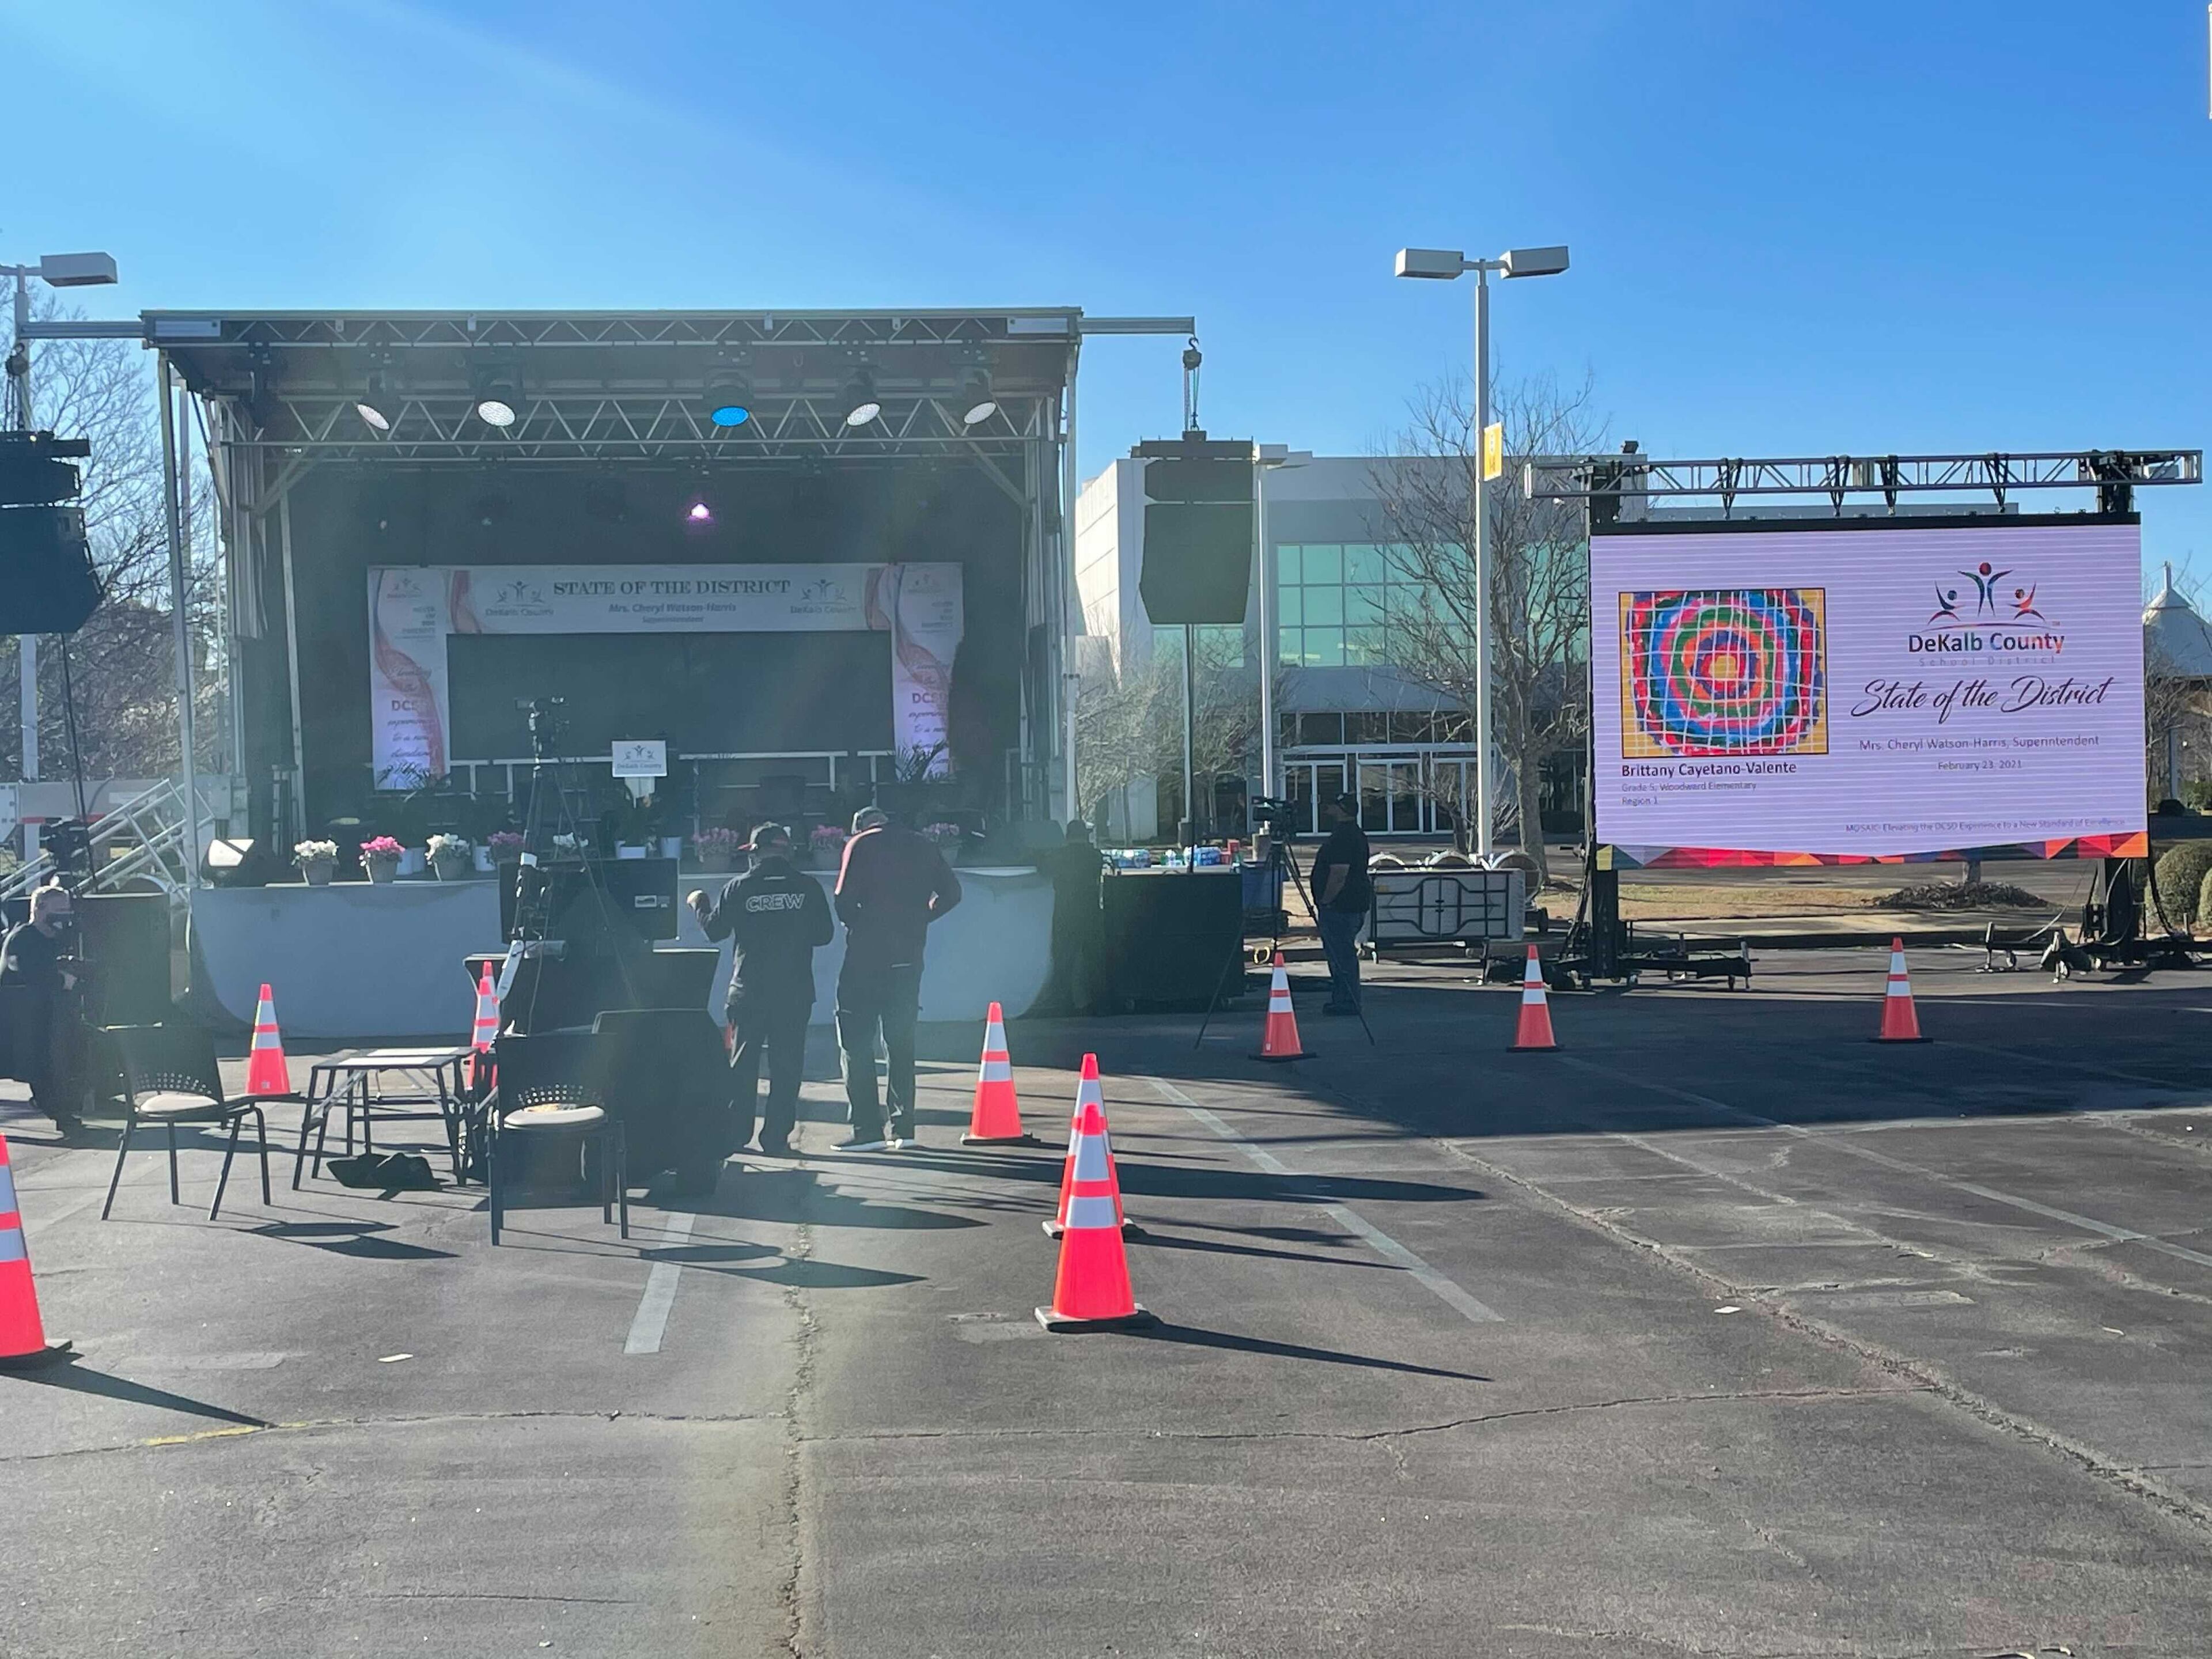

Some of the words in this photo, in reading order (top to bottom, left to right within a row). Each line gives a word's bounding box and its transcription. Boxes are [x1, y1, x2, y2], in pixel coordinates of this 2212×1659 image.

[554, 581, 615, 595] STATE
[620, 581, 646, 594] OF
[651, 581, 691, 594] THE
[696, 579, 791, 594] DISTRICT
[632, 604, 664, 615] Cheryl
[666, 603, 737, 612] Watson-Harris
[1908, 632, 1983, 652] DeKalb
[1990, 632, 2065, 654] County
[1919, 657, 1976, 666] School
[1988, 655, 2055, 665] District
[1851, 679, 1930, 717] State
[1933, 680, 1963, 725] of
[1961, 679, 1999, 707] the
[2001, 675, 2122, 713] District
[1888, 738, 1923, 752] Cheryl
[2013, 734, 2100, 748] Superintendent
[1622, 763, 1675, 778] Brittany
[1679, 760, 1797, 778] Cayetano-Valente
[1938, 761, 1980, 771] February
[1999, 759, 2022, 769] 2021
[1622, 783, 1646, 792] Grade
[1660, 781, 1706, 791] Woodward
[1708, 780, 1757, 791] Elementary
[1622, 796, 1650, 806] Region
[1959, 821, 2001, 831] Experience
[2038, 819, 2074, 828] Standard
[746, 893, 805, 912] CREW
